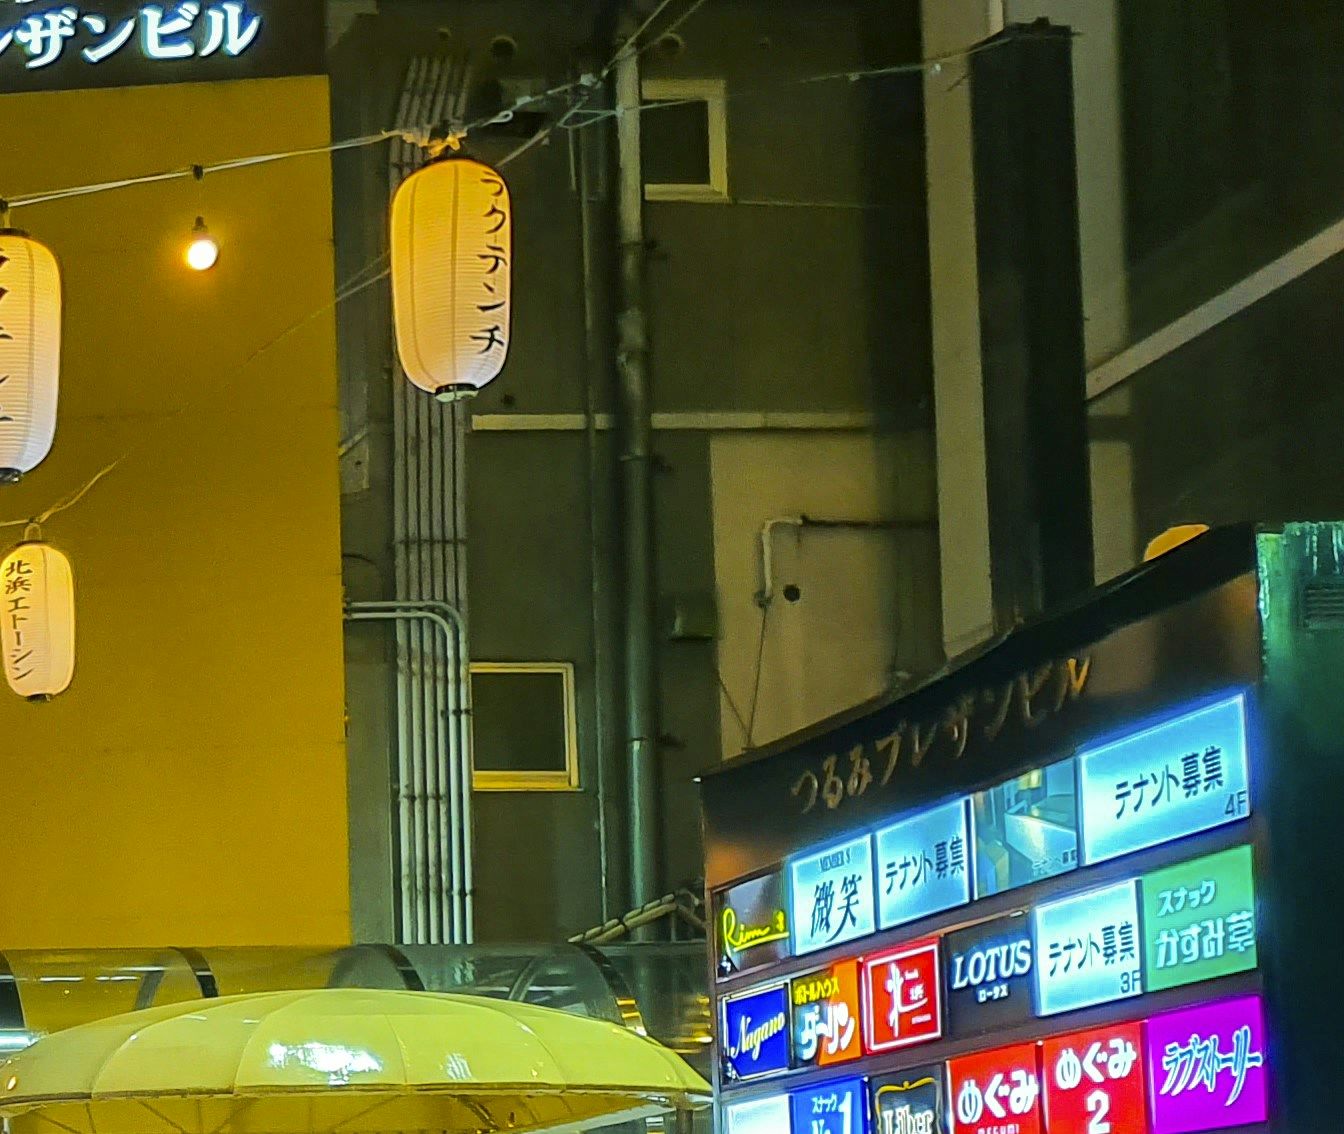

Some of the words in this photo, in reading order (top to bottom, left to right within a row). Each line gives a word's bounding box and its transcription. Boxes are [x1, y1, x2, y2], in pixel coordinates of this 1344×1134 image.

[469, 172, 507, 355] ラクテンチ
[5, 560, 33, 680] 北浜エトーシン
[1113, 745, 1225, 819] テナント募集
[1224, 789, 1248, 818] 4F
[884, 834, 967, 896] テナント募集
[811, 875, 862, 943] 微笑
[1157, 880, 1216, 917] スナック
[952, 939, 1032, 990] LOTUS
[1049, 921, 1135, 977] テナント募集
[1155, 911, 1254, 969] かすみ草
[794, 976, 840, 1006] ボトルハウス
[978, 983, 1009, 1003] ロータス
[730, 1011, 786, 1061] Nagano
[798, 1001, 855, 1061] ダーリン
[1056, 1038, 1137, 1090] めぐみ
[1160, 1025, 1262, 1107] ラブストーリー
[812, 1094, 838, 1114] スナック
[958, 1070, 1039, 1123] めぐみ
